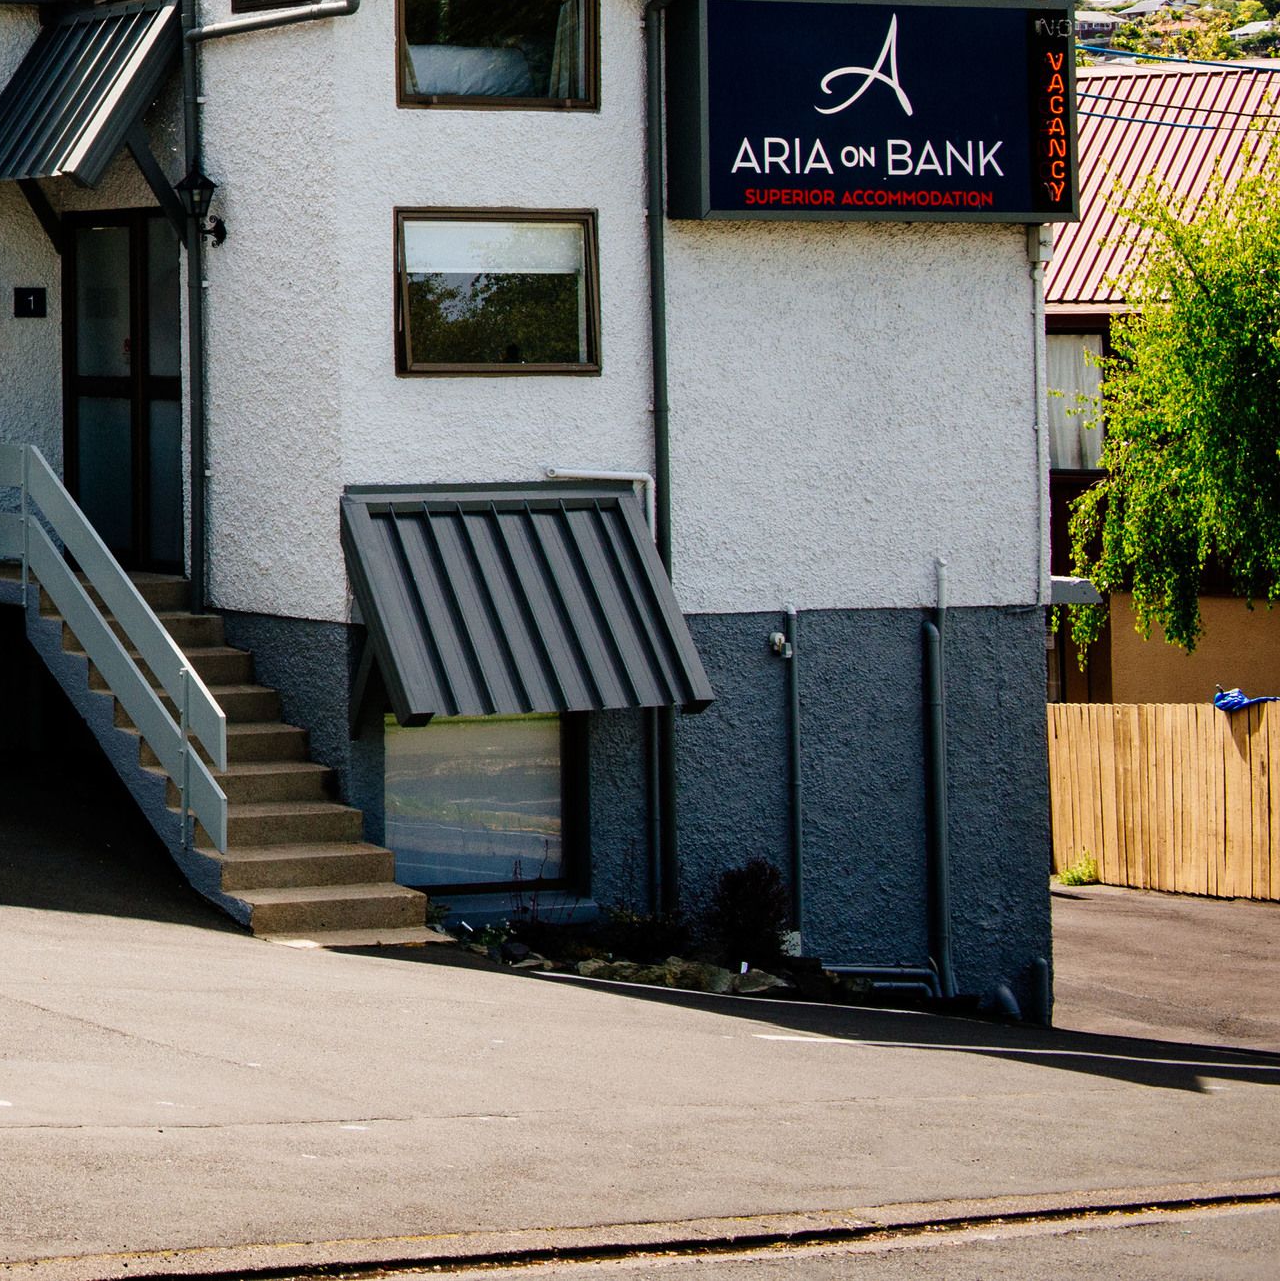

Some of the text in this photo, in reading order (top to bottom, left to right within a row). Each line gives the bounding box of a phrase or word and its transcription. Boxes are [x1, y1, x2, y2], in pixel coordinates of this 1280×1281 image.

[1040, 18, 1073, 38] NO
[1047, 51, 1067, 202] VACANCY
[731, 136, 1005, 177] ARIA ON BANK
[744, 188, 994, 207] SUPERIOR ACCOMMODATION
